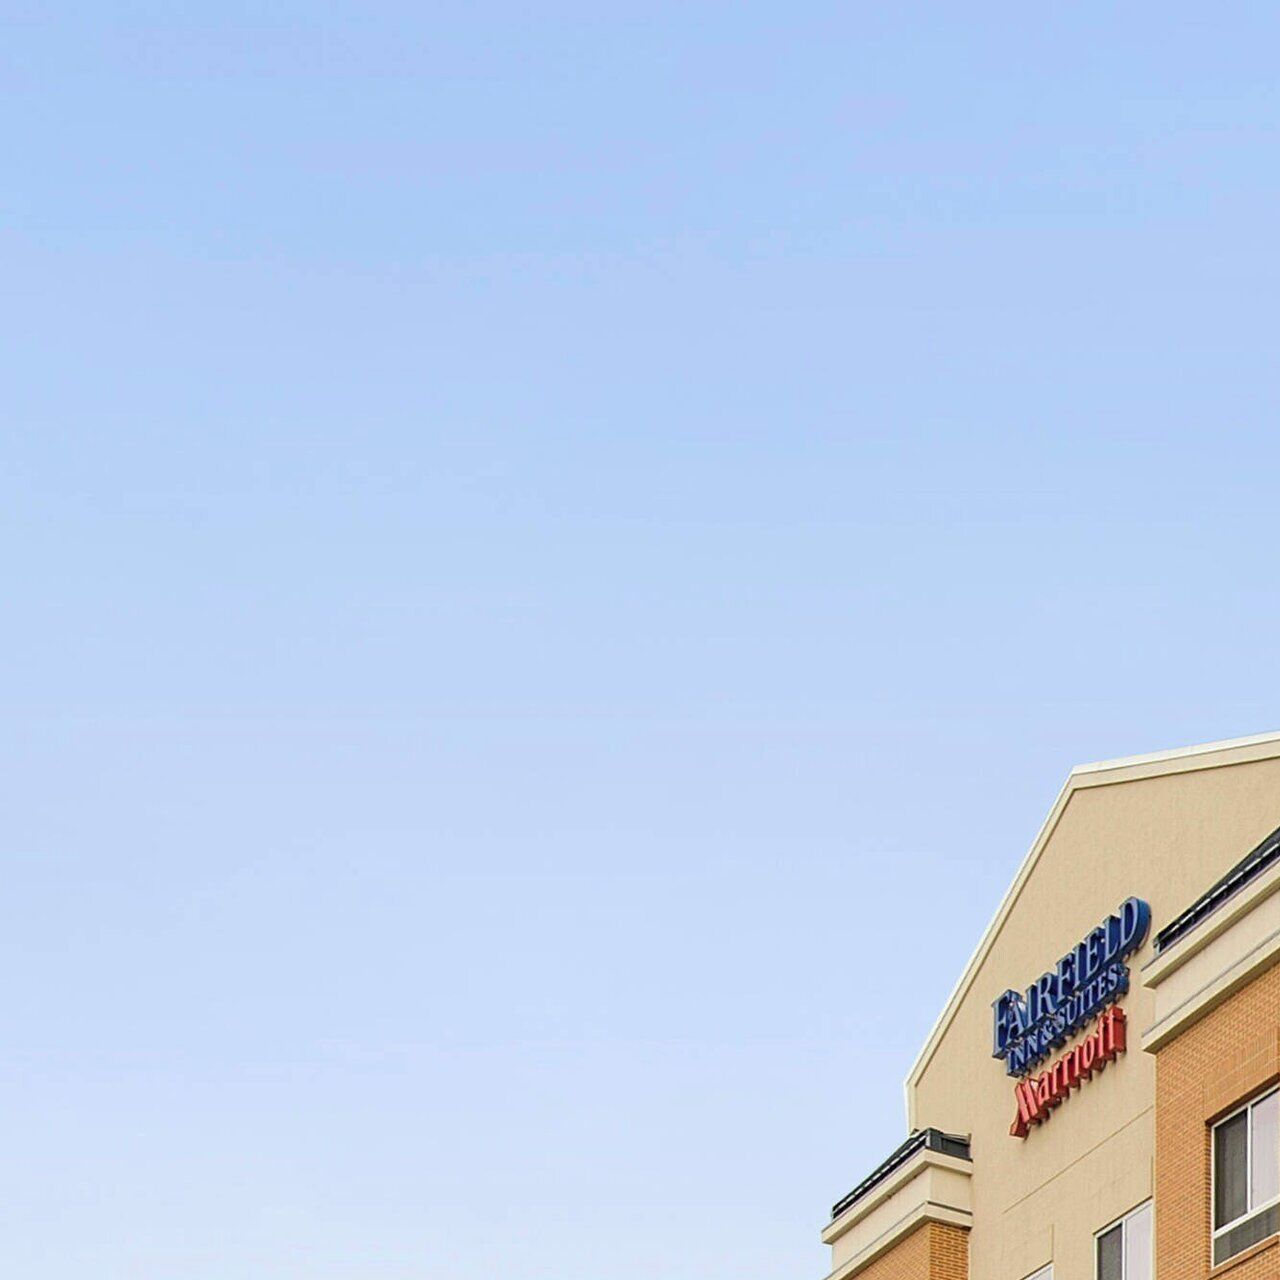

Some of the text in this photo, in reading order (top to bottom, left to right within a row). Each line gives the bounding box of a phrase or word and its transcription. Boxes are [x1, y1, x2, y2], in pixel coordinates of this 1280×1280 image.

[992, 896, 1151, 1059] FAIRFIELD
[1052, 961, 1128, 1034] SUITES
[1010, 1004, 1126, 1138] Marriott
